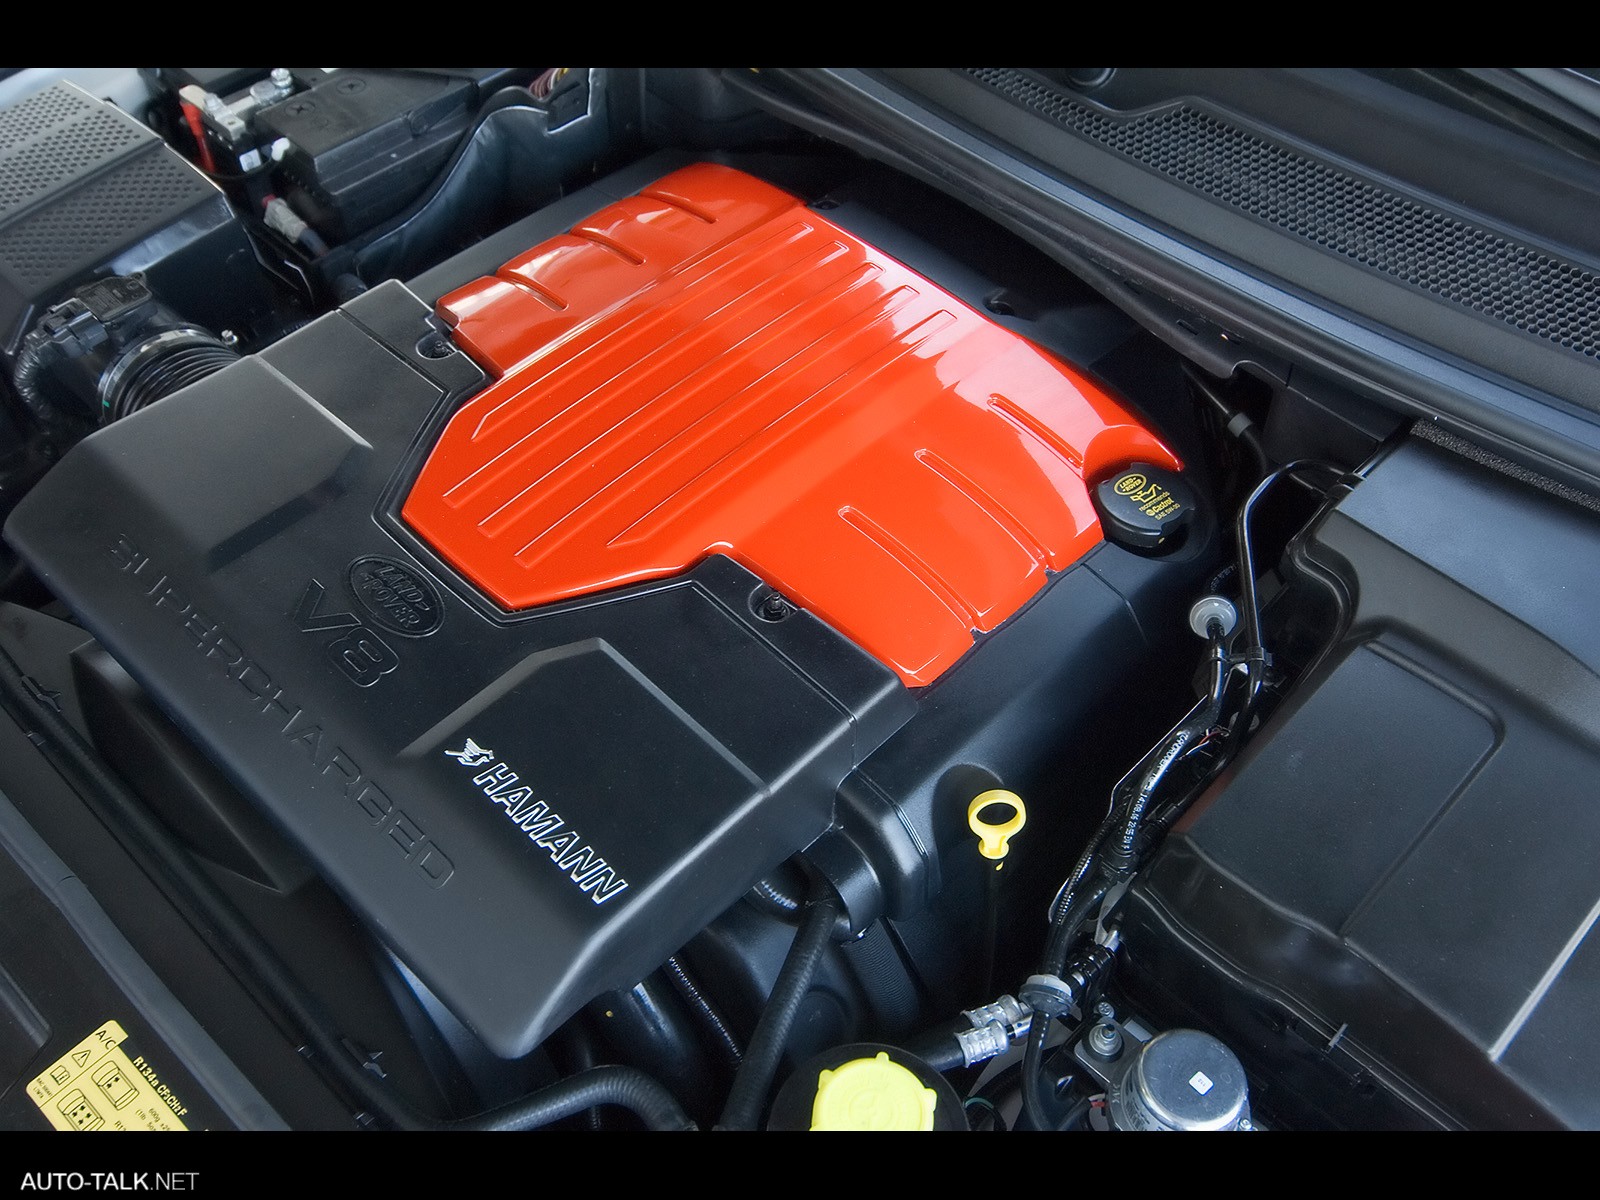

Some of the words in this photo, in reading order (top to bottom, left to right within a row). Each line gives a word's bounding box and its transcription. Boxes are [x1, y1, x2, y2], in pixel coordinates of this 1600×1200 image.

[1152, 497, 1175, 512] Castrol
[292, 577, 401, 688] V8
[107, 531, 457, 891] SUPERCHARGED
[471, 761, 629, 904] HAMANN
[95, 1029, 117, 1050] A/C
[133, 1055, 159, 1088] R134a
